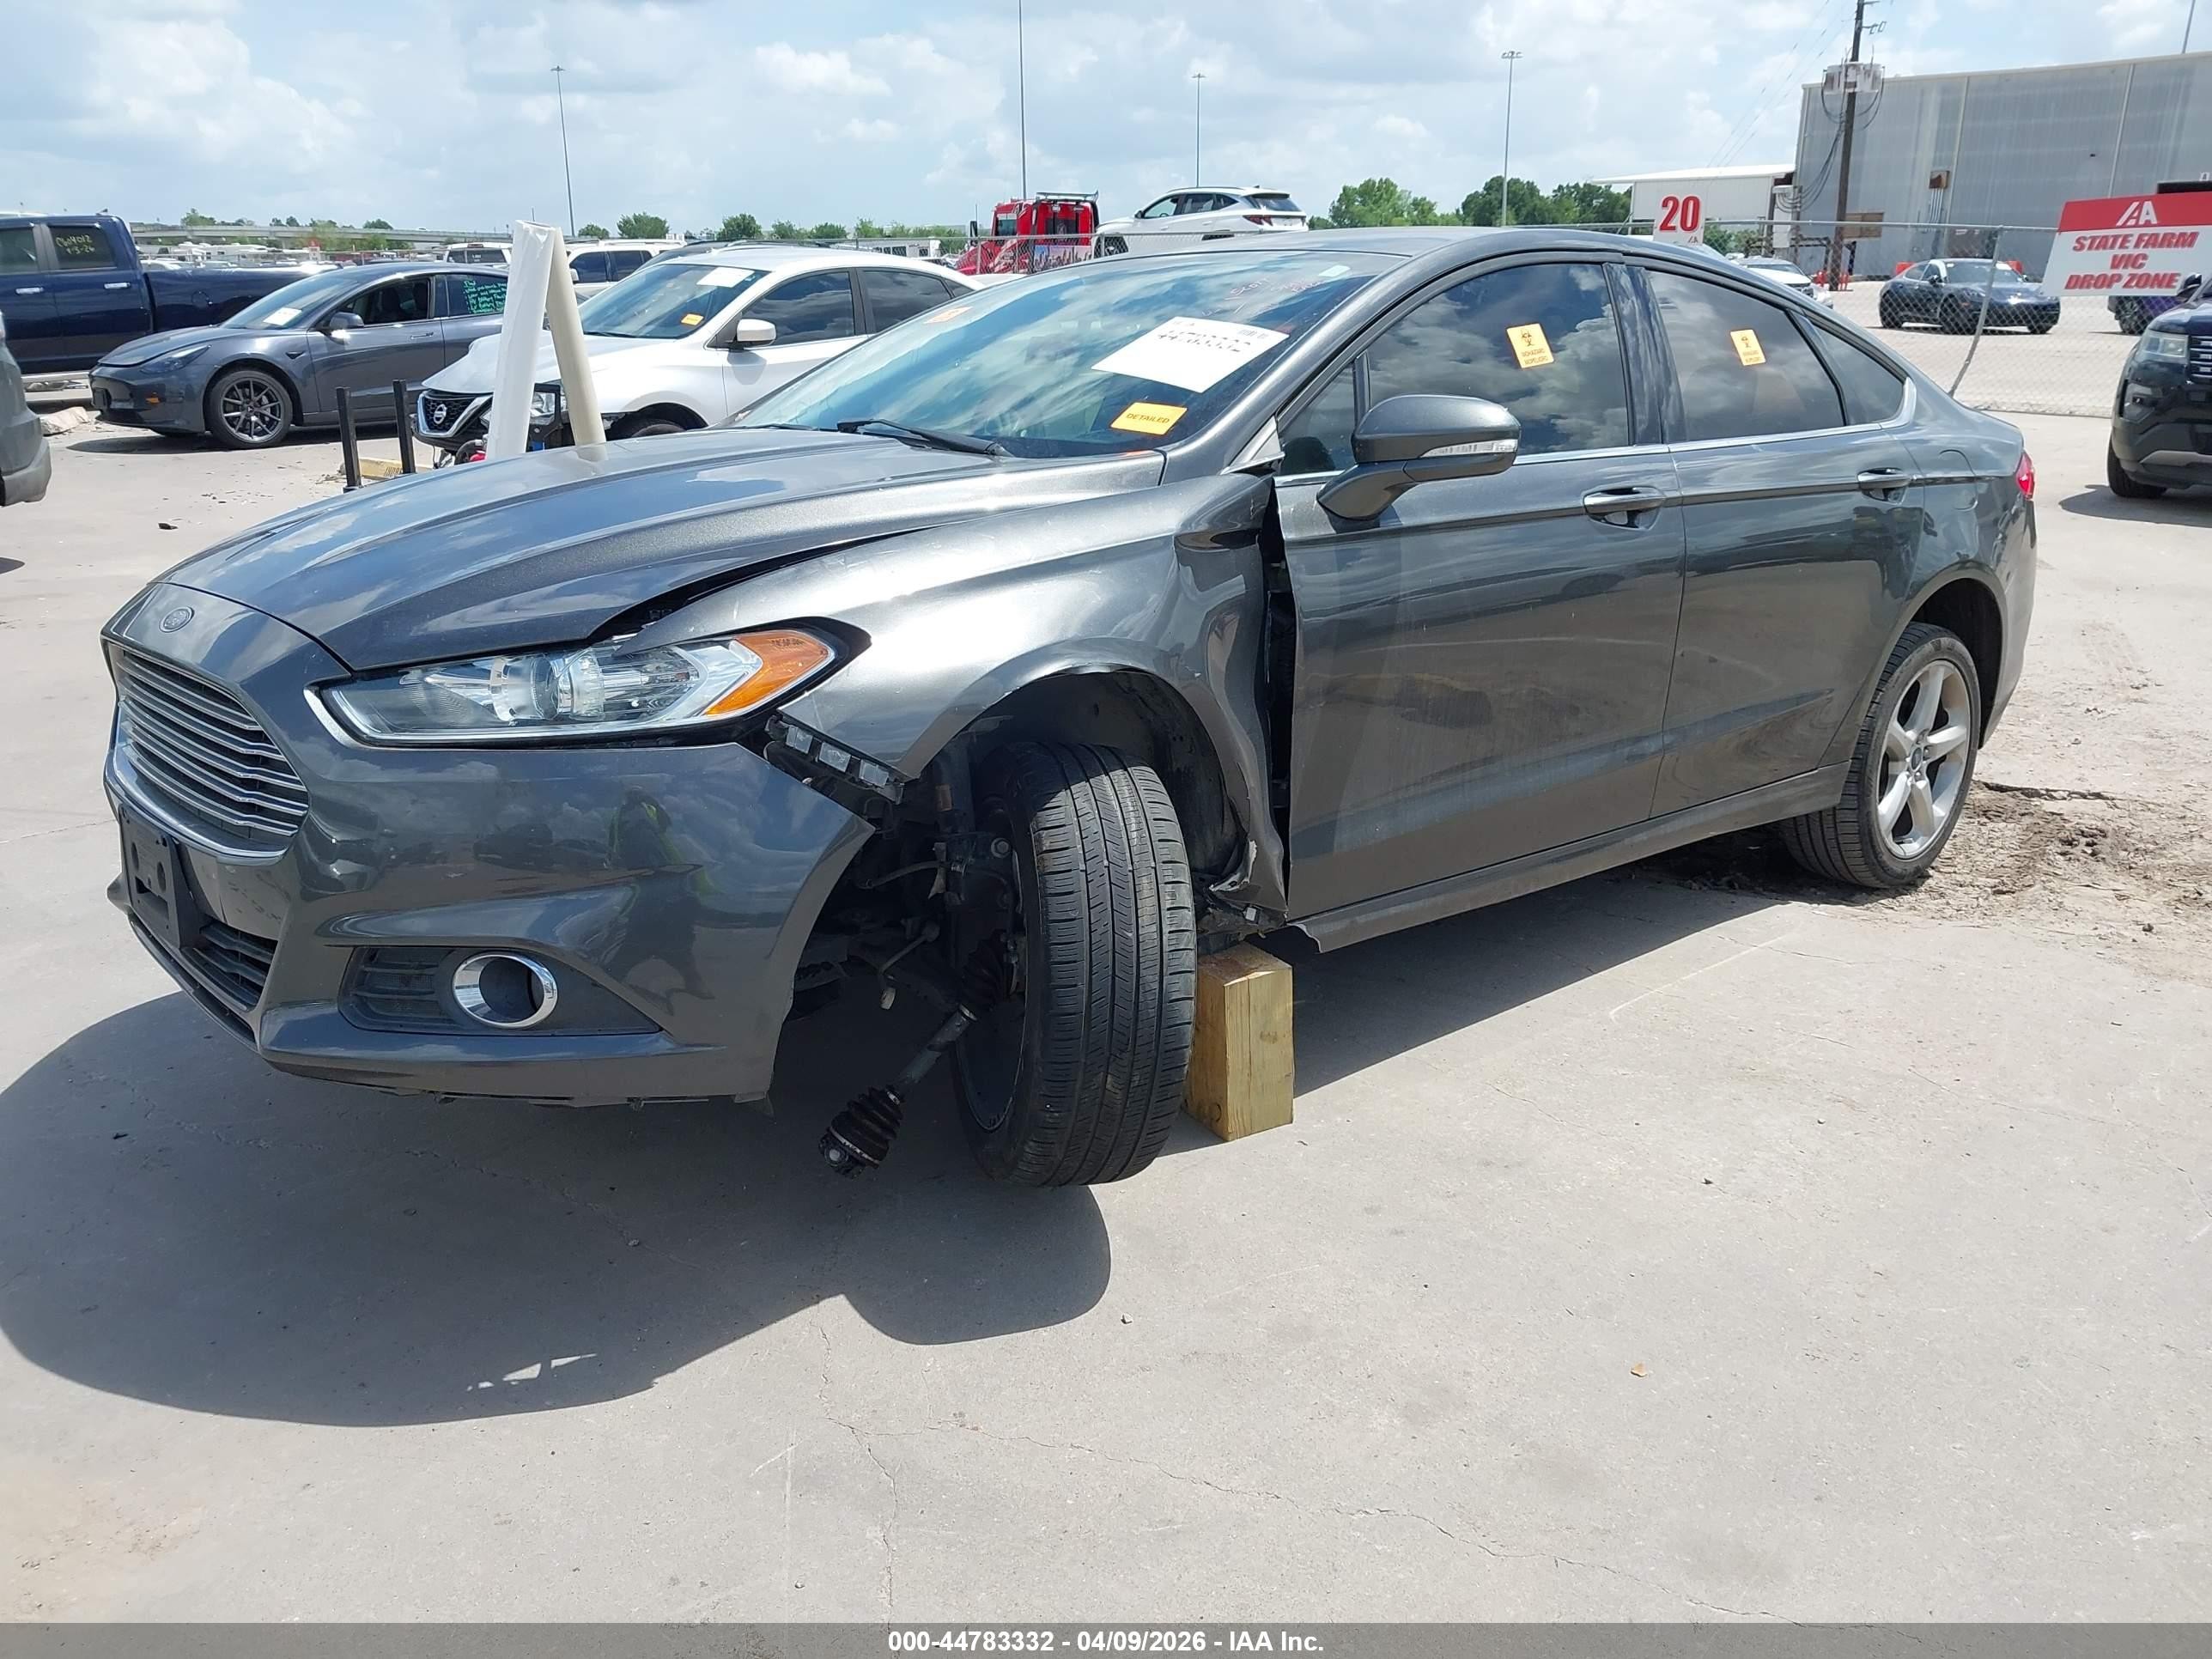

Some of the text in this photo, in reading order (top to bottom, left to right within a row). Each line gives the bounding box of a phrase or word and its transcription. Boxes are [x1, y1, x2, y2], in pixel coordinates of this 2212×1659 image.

[1659, 195, 1700, 232] 20
[2072, 231, 2199, 252] STATE FARM
[2110, 252, 2149, 270] VIC
[2064, 272, 2182, 290] DROP ZONE
[1126, 412, 1170, 424] DETAILED
